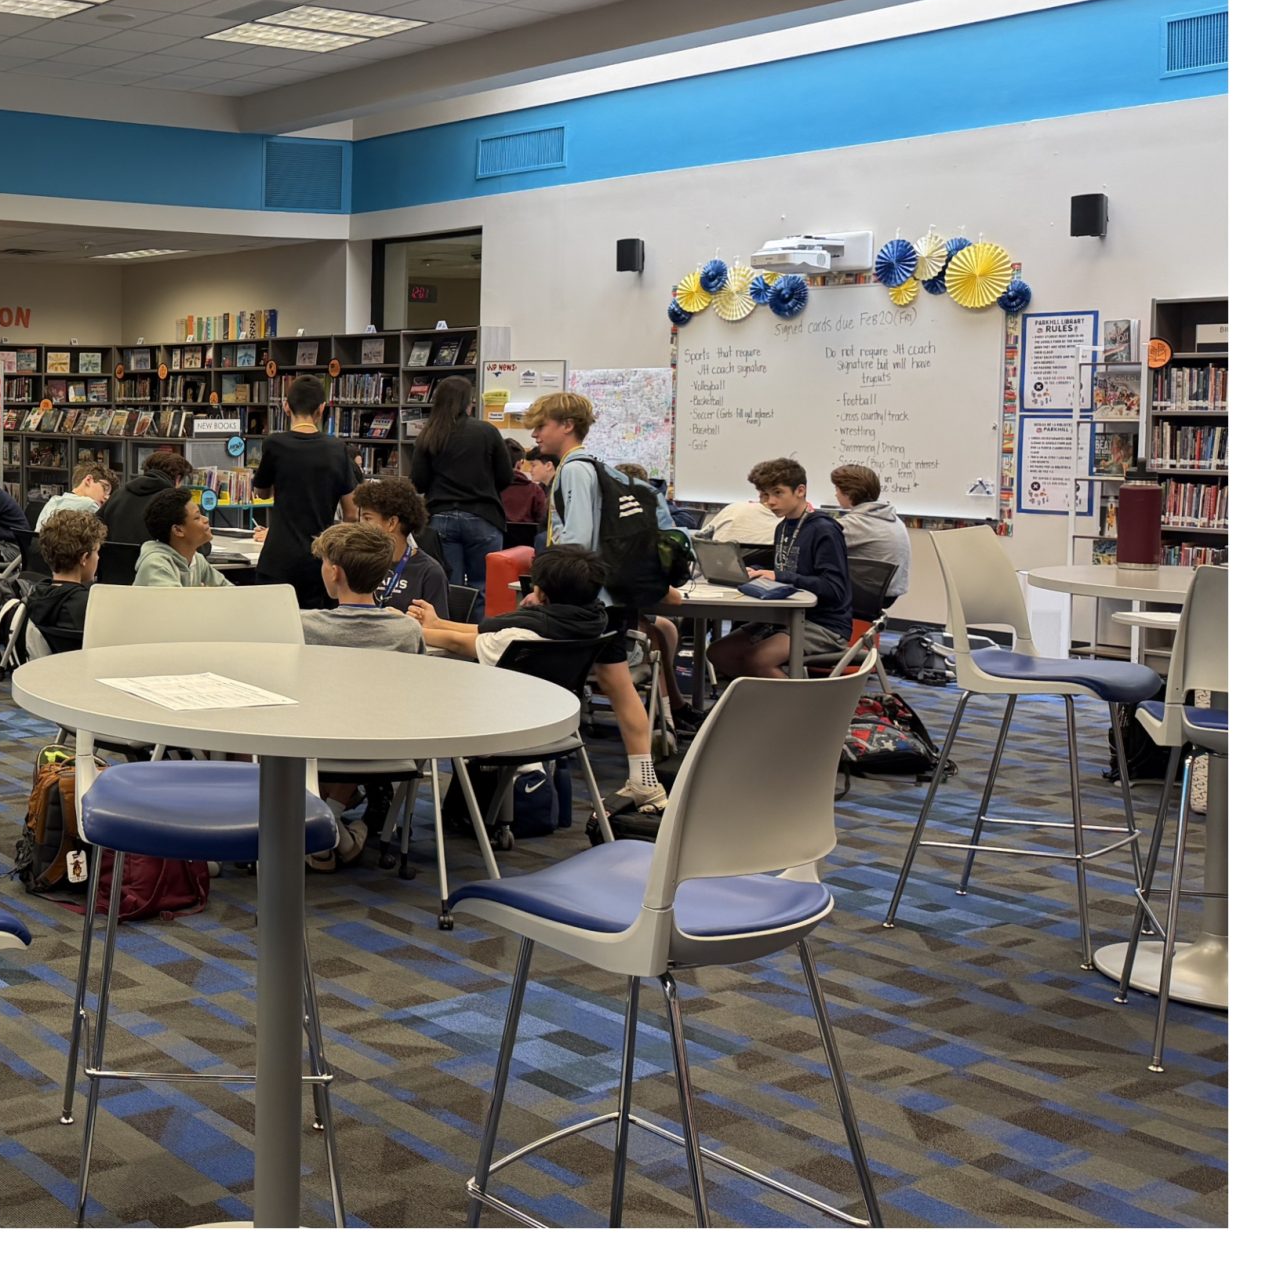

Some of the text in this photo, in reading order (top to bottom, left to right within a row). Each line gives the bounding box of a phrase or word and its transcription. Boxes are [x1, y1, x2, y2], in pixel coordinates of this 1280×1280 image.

[808, 316, 832, 334] cards
[835, 314, 854, 332] due
[1045, 324, 1073, 333] RULES
[684, 345, 761, 365] Sports that require
[825, 346, 837, 359] Do
[841, 345, 854, 358] not
[859, 347, 888, 361] require
[907, 340, 936, 356] coach
[711, 361, 735, 375] coach
[737, 359, 768, 378] signature
[876, 358, 889, 370] but
[892, 357, 907, 369] will
[911, 357, 931, 370] have
[861, 372, 892, 387] tryouts
[197, 421, 237, 430] NEW BOOKS
